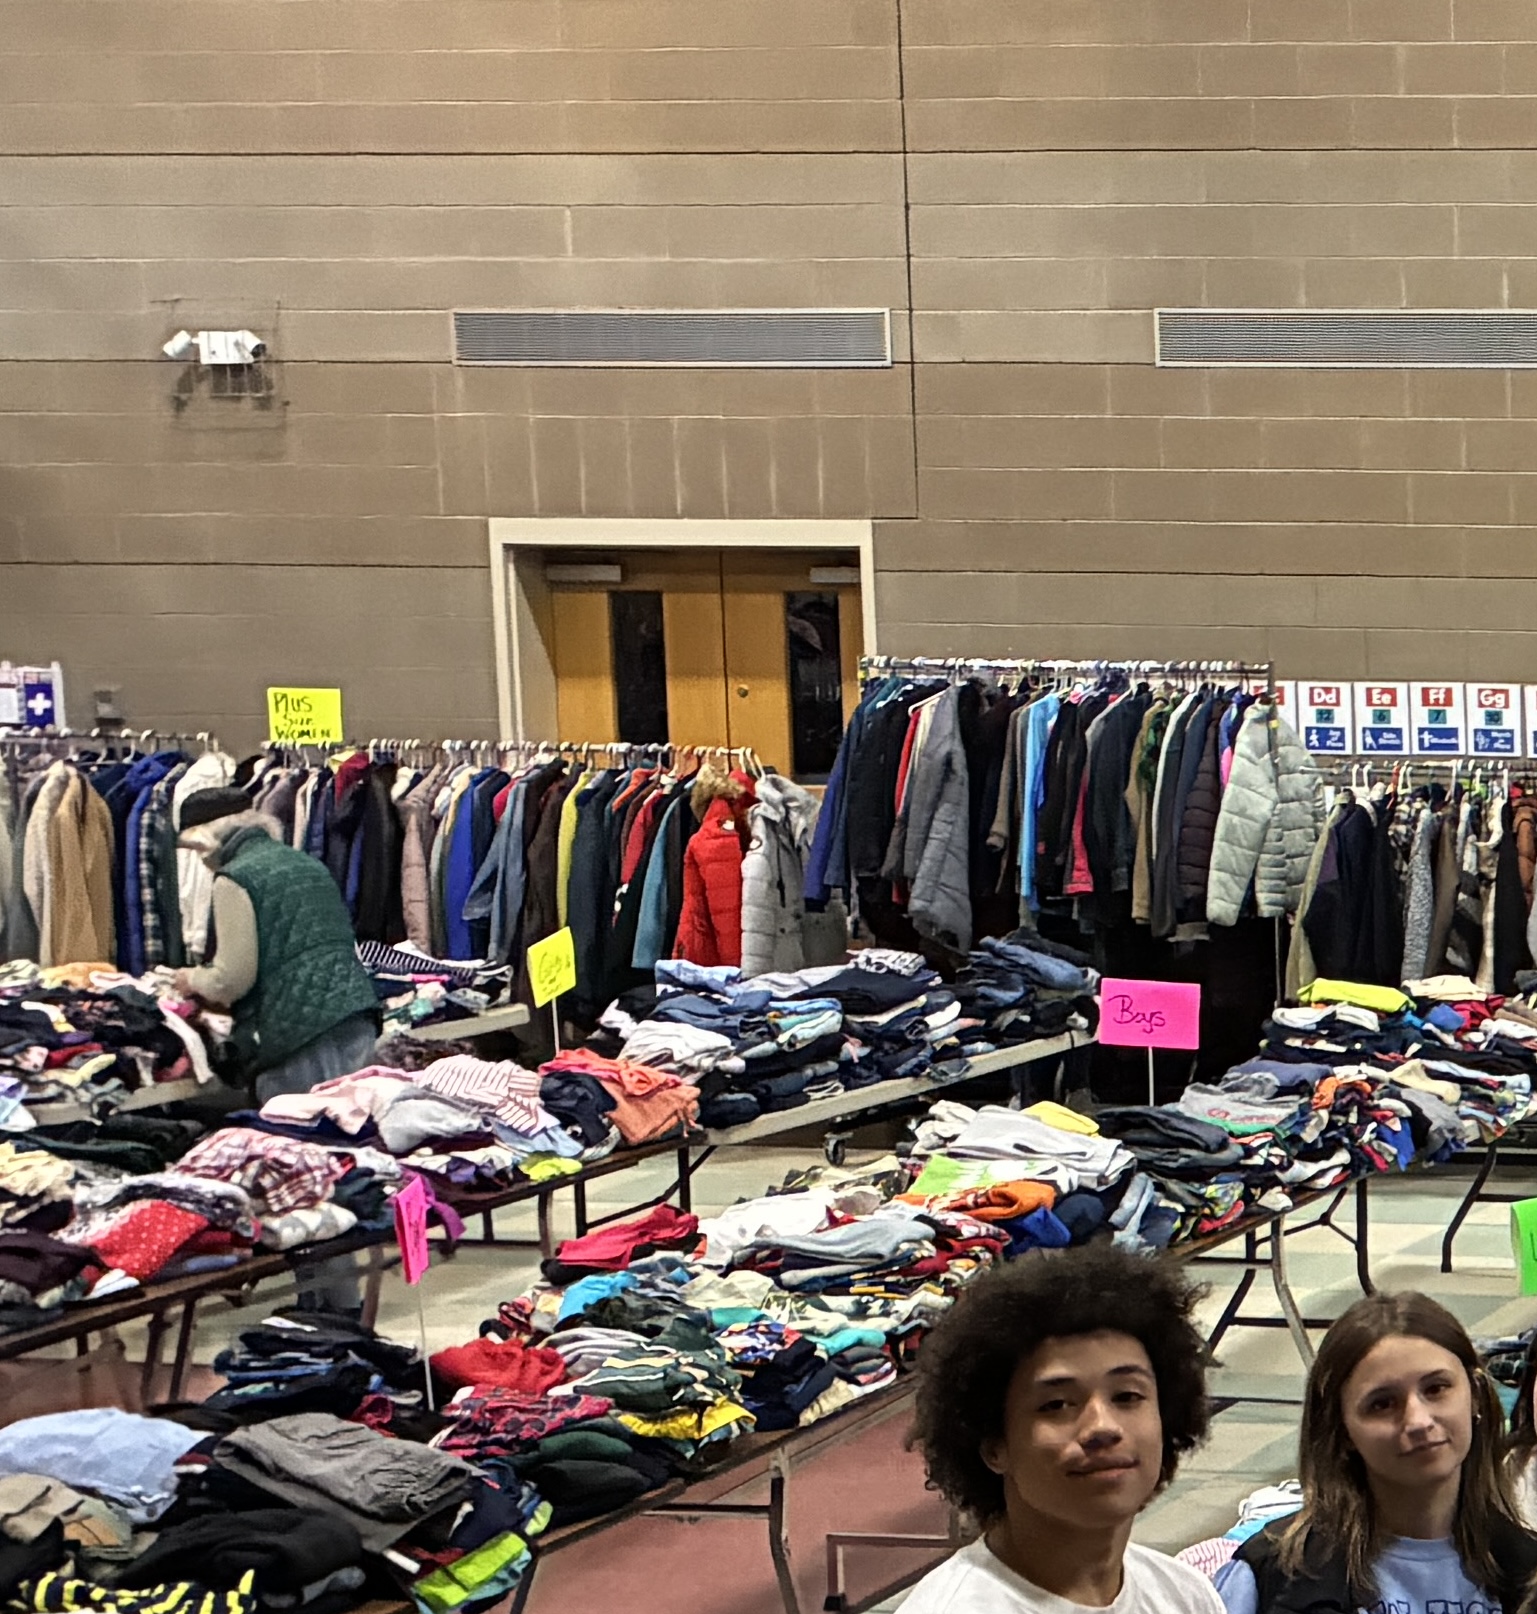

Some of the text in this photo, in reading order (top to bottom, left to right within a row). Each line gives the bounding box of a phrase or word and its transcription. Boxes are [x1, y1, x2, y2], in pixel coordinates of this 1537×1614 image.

[1314, 688, 1336, 703] Dd
[1372, 689, 1391, 704] Ee
[1429, 689, 1445, 704] Ff
[1482, 690, 1505, 707] Gg
[1108, 994, 1166, 1034] Boys
